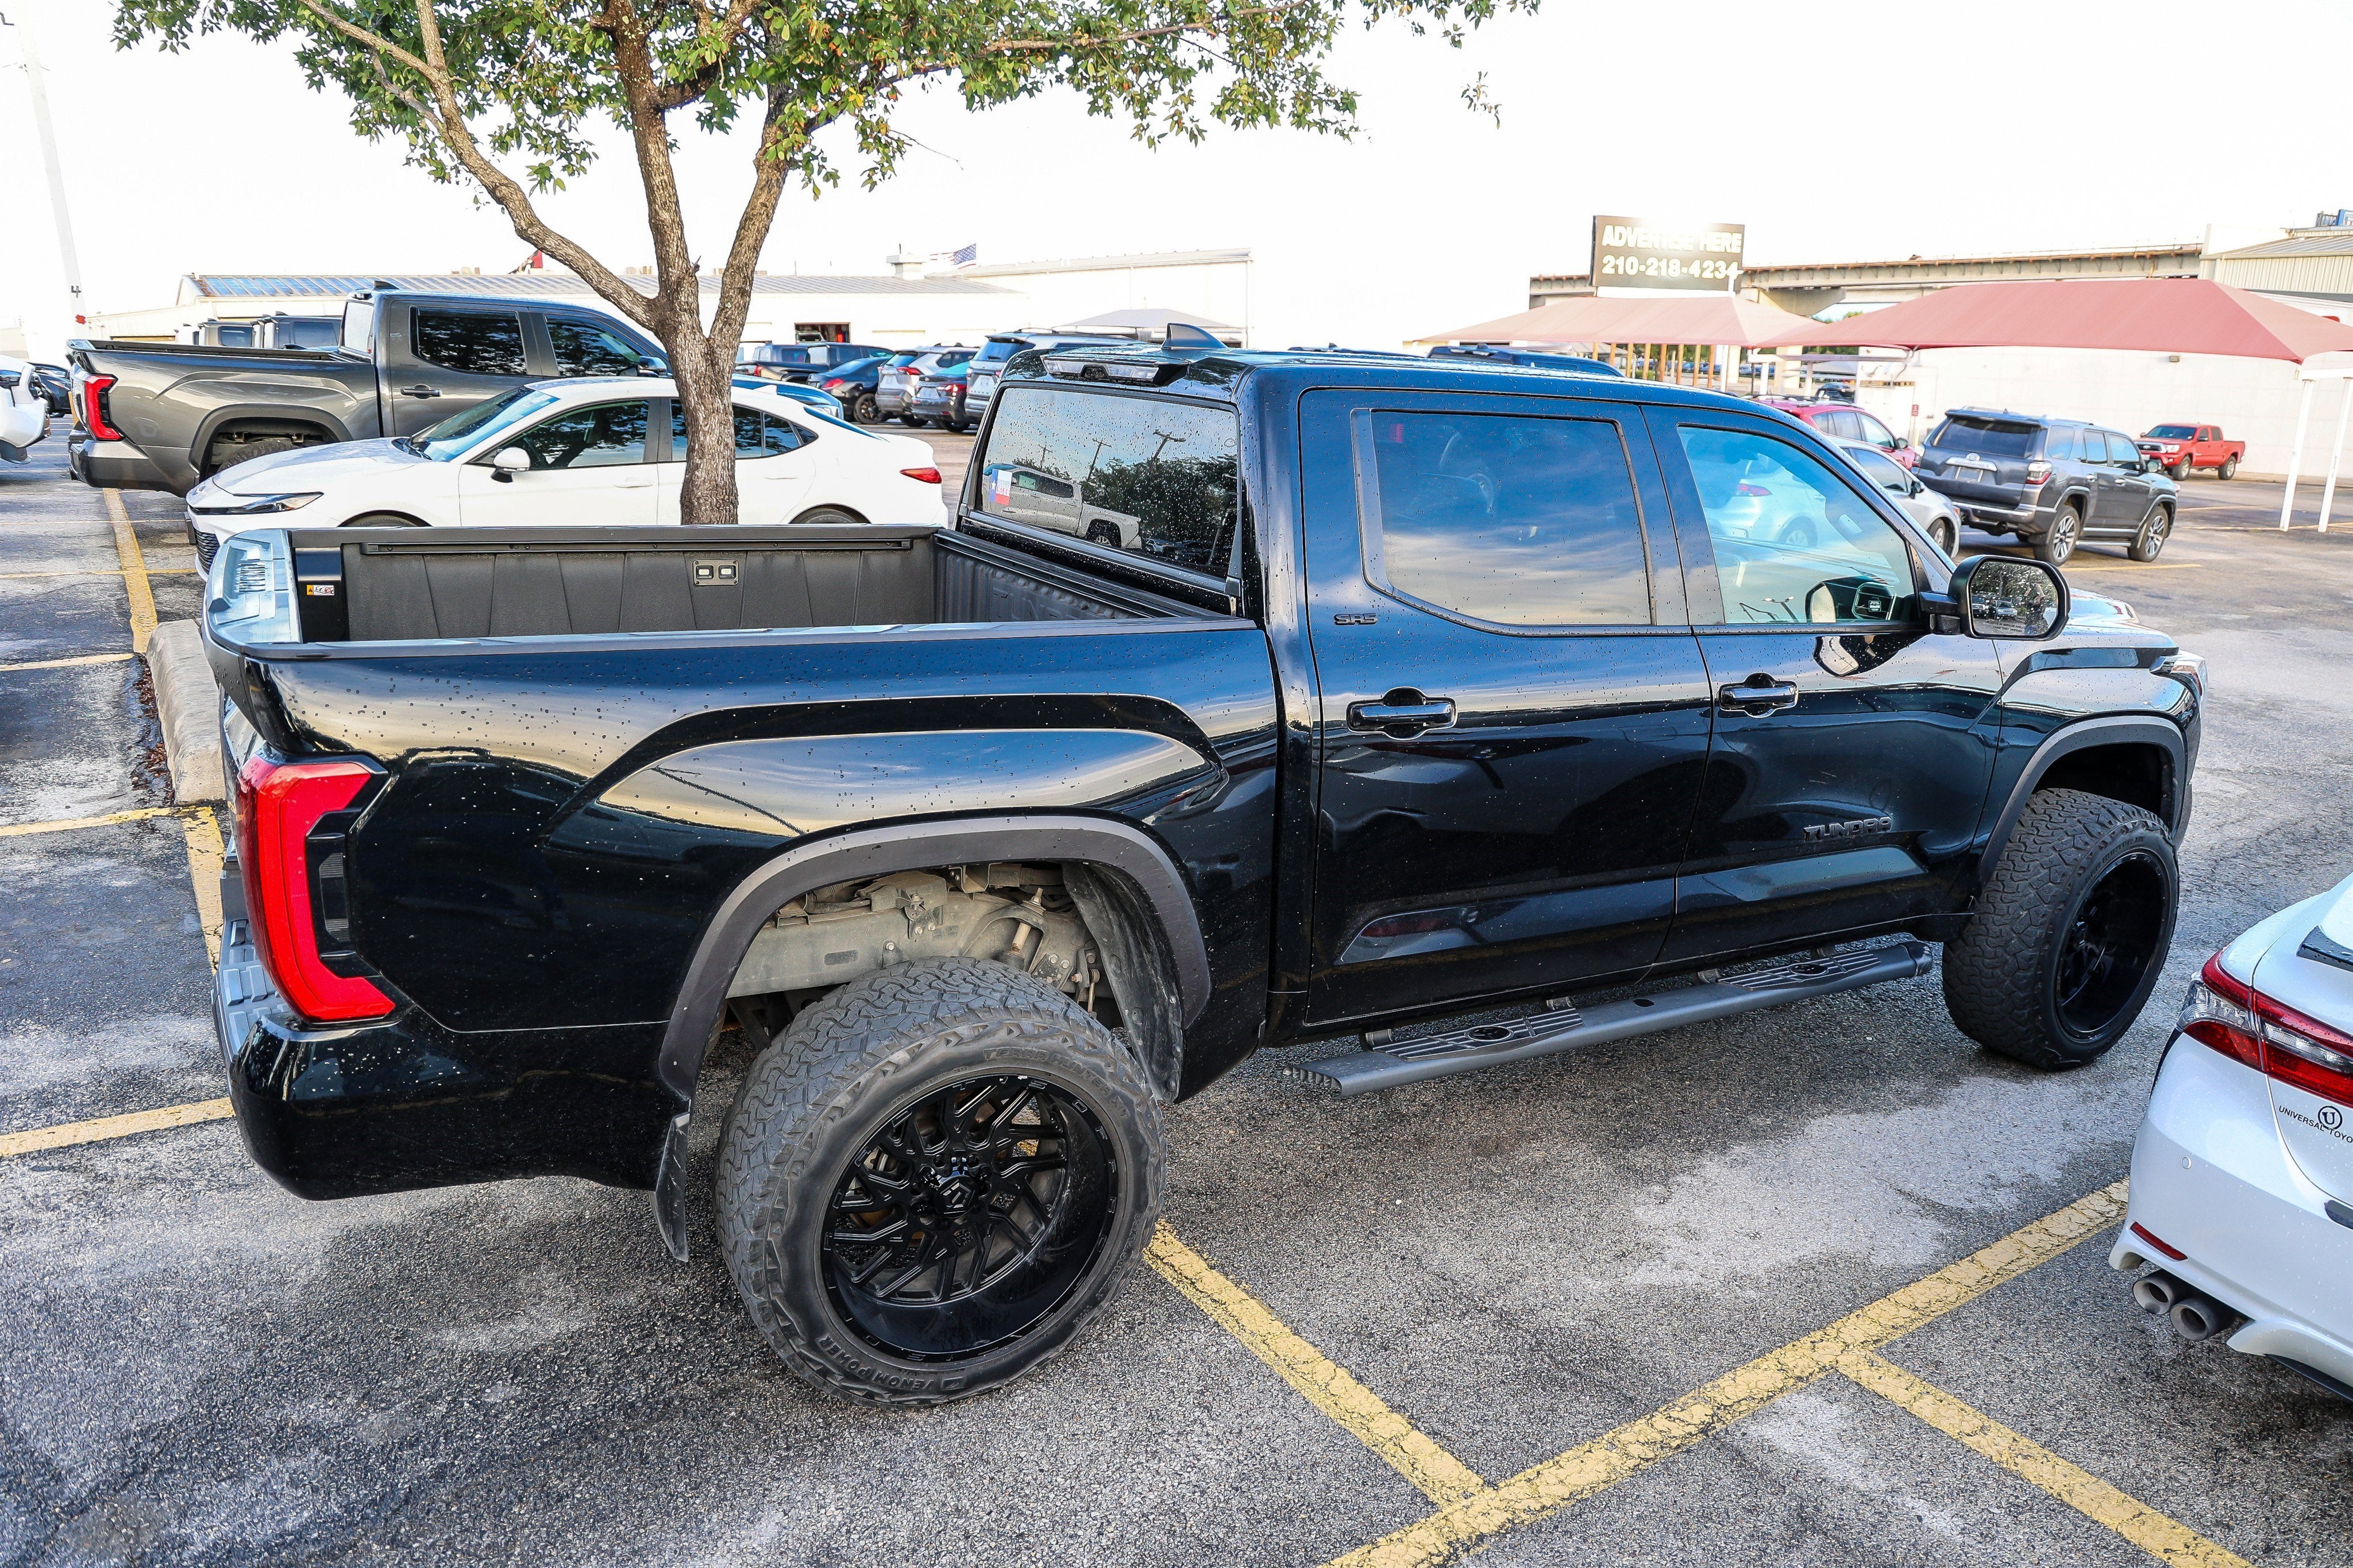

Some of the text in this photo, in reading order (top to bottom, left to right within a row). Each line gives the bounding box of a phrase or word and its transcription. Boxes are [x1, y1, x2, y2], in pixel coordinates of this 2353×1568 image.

[1699, 230, 1742, 254] HERE
[71, 285, 82, 298] 4
[1333, 613, 1378, 625] SR5
[1803, 816, 1892, 842] TUNDRA
[983, 1047, 1050, 1061] TERRA
[1050, 1053, 1112, 1096] HUNTER
[2278, 1105, 2325, 1132] UNIVERSAL
[818, 1334, 934, 1390] VENOM POWER
